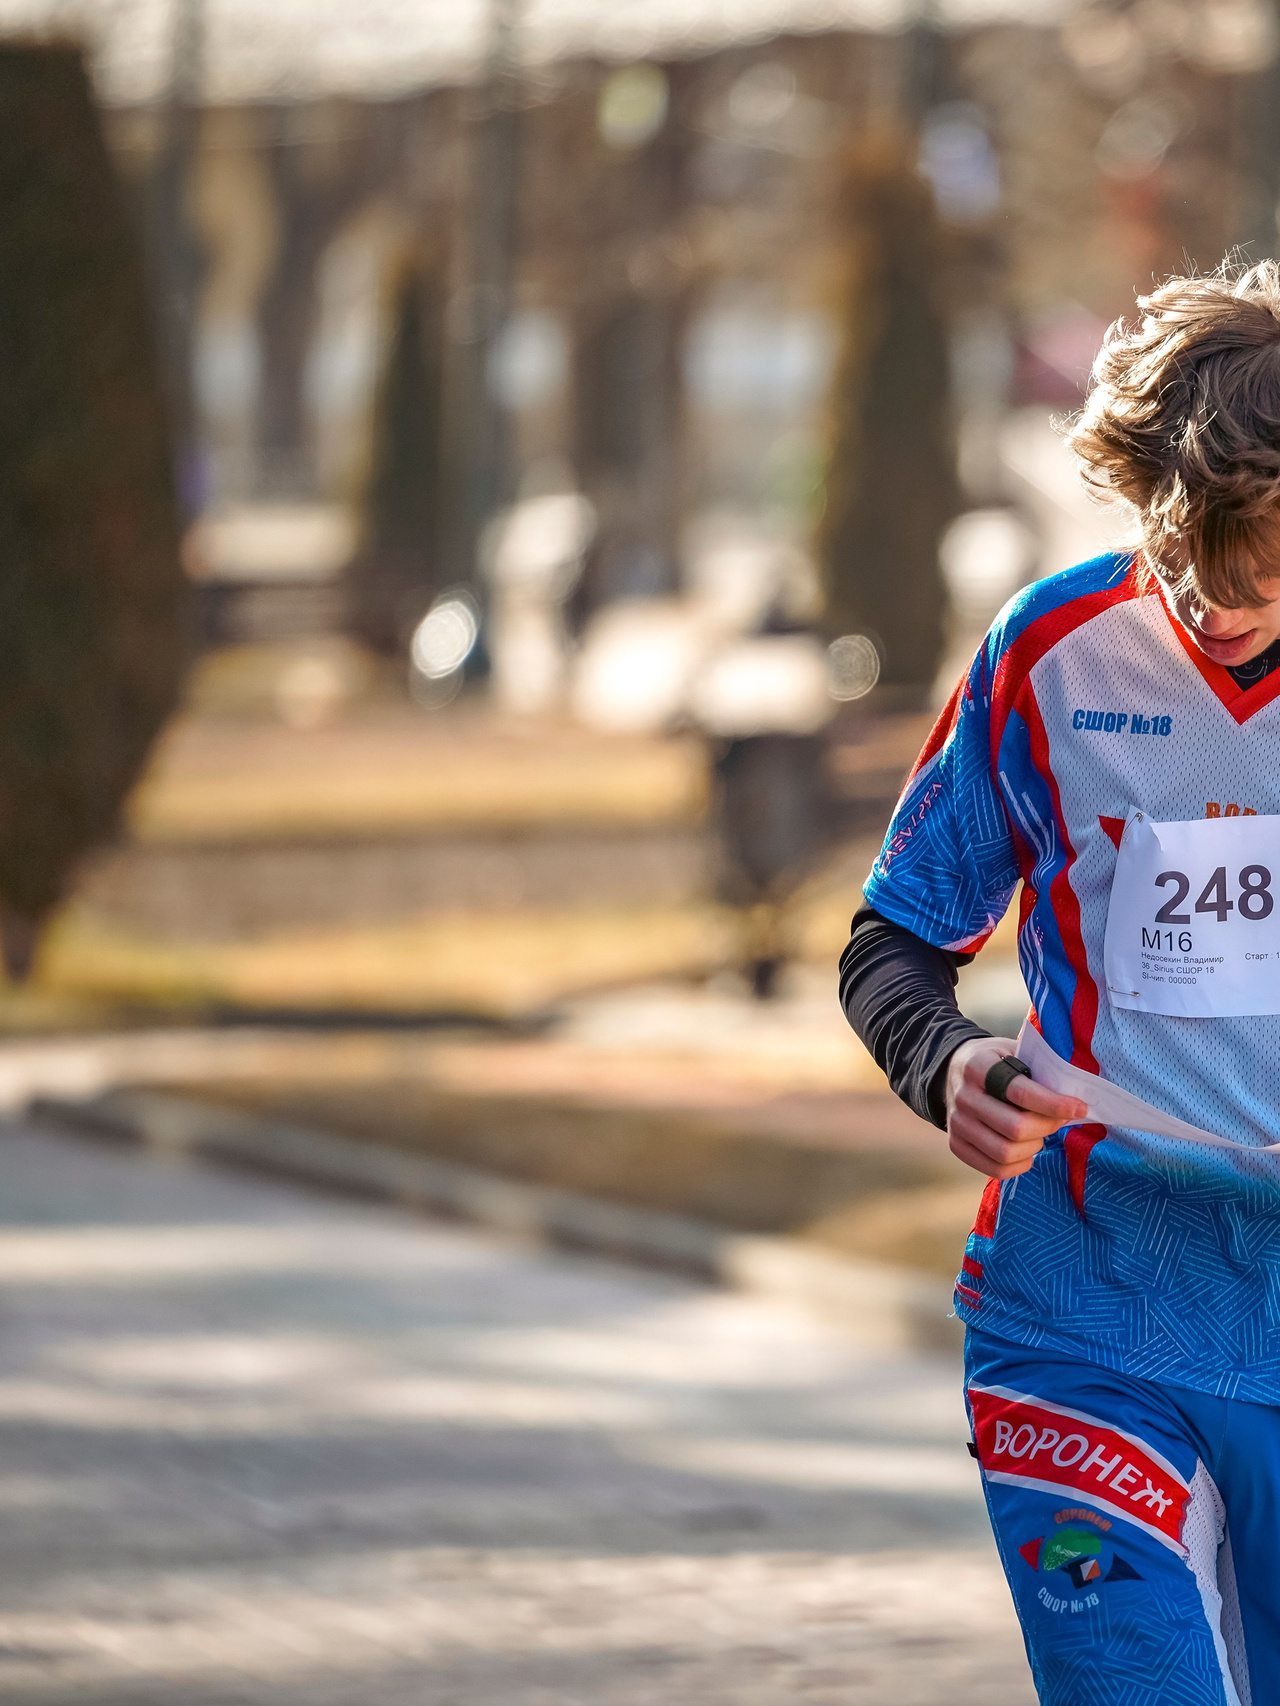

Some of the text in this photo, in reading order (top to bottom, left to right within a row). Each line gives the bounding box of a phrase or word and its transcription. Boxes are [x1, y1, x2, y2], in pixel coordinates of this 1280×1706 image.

[1072, 709, 1173, 737] СШОР №18
[1154, 864, 1274, 925] 248
[1141, 927, 1193, 952] М16
[1141, 951, 1225, 965] Недосекин Владимир
[1244, 952, 1269, 961] Старт
[1168, 976, 1197, 985] 000000
[1176, 966, 1203, 974] СШОР
[1205, 966, 1215, 974] 18
[993, 1420, 1174, 1518] ВОРОНЕЖ
[1037, 1586, 1068, 1614] СШОР
